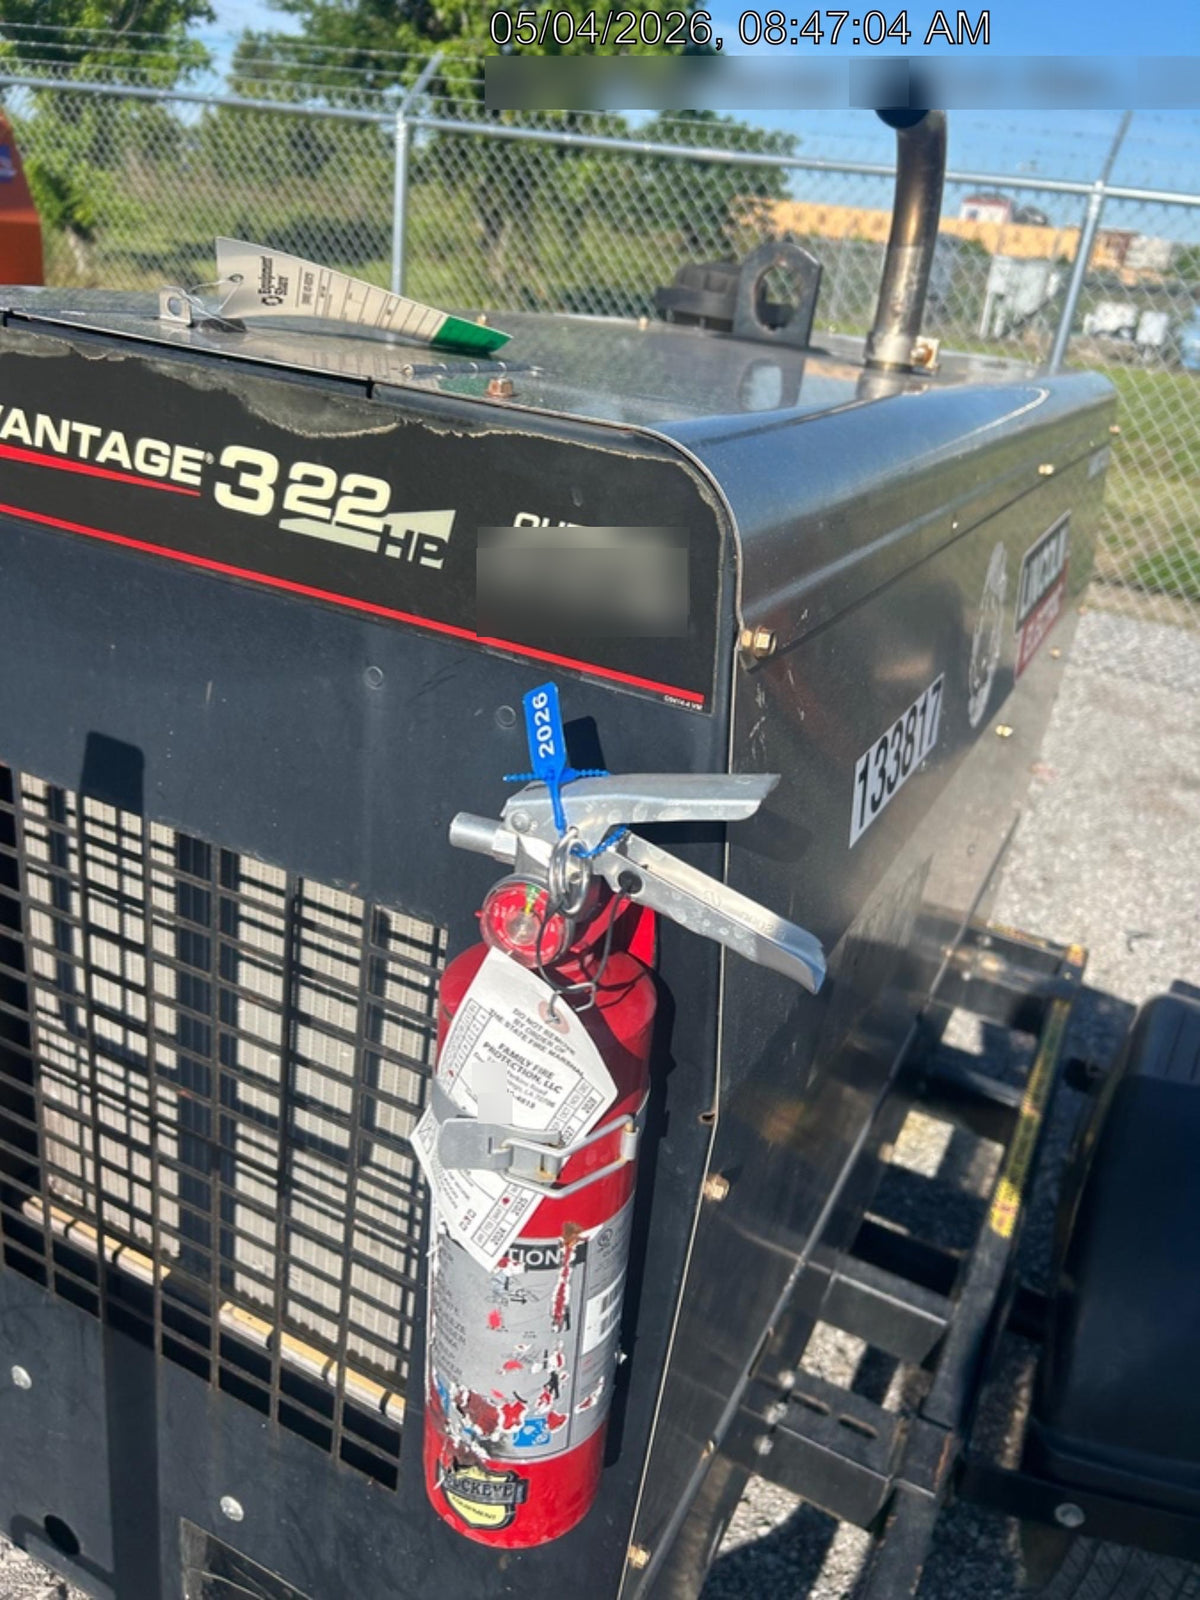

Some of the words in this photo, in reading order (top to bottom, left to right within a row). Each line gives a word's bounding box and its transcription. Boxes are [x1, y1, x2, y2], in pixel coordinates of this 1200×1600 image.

[0, 405, 202, 485] ANTAGE
[214, 445, 392, 532] 322
[532, 692, 555, 759] 2026
[857, 680, 943, 830] 133817
[498, 1042, 533, 1069] FAMILY
